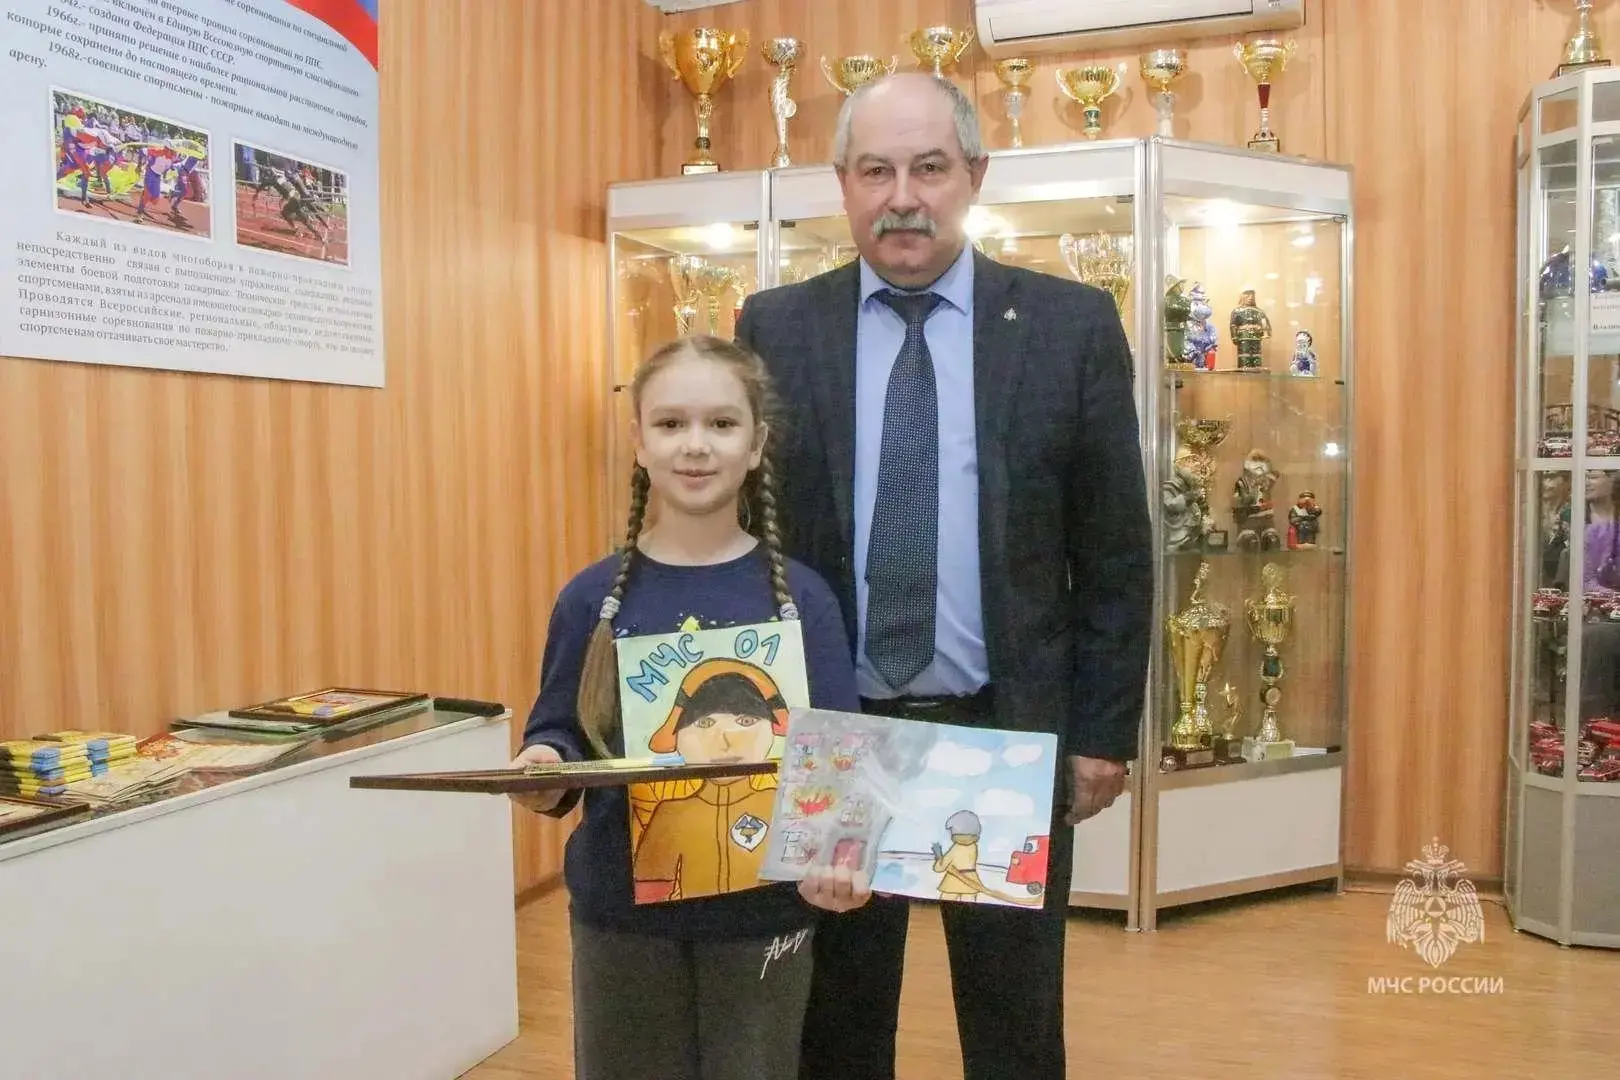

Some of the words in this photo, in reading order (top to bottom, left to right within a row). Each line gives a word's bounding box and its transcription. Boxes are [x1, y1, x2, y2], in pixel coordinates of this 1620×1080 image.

[88, 4, 129, 27] создана
[133, 19, 185, 49] Федерация
[187, 39, 207, 55] ППС
[210, 47, 235, 65] СССР.
[88, 21, 136, 48] принято
[138, 39, 178, 62] решение
[189, 55, 228, 78] наиболее
[7, 10, 62, 39] которые
[65, 31, 122, 59] сохранены
[139, 55, 197, 84] настоящего
[199, 76, 237, 97] времени.
[9, 47, 47, 69] арену.
[210, 95, 253, 117] пожарные
[16, 238, 115, 266] непосредственно
[127, 258, 160, 272] связан
[56, 229, 106, 249] Каждый
[18, 256, 74, 274] элементы
[81, 264, 118, 280] боевой
[124, 273, 179, 290] подготовки
[18, 287, 93, 309] Проводятся
[20, 304, 97, 324] гарнизонные
[102, 315, 173, 333] соревнования
[626, 633, 704, 703] МЧС
[734, 629, 781, 666] 01
